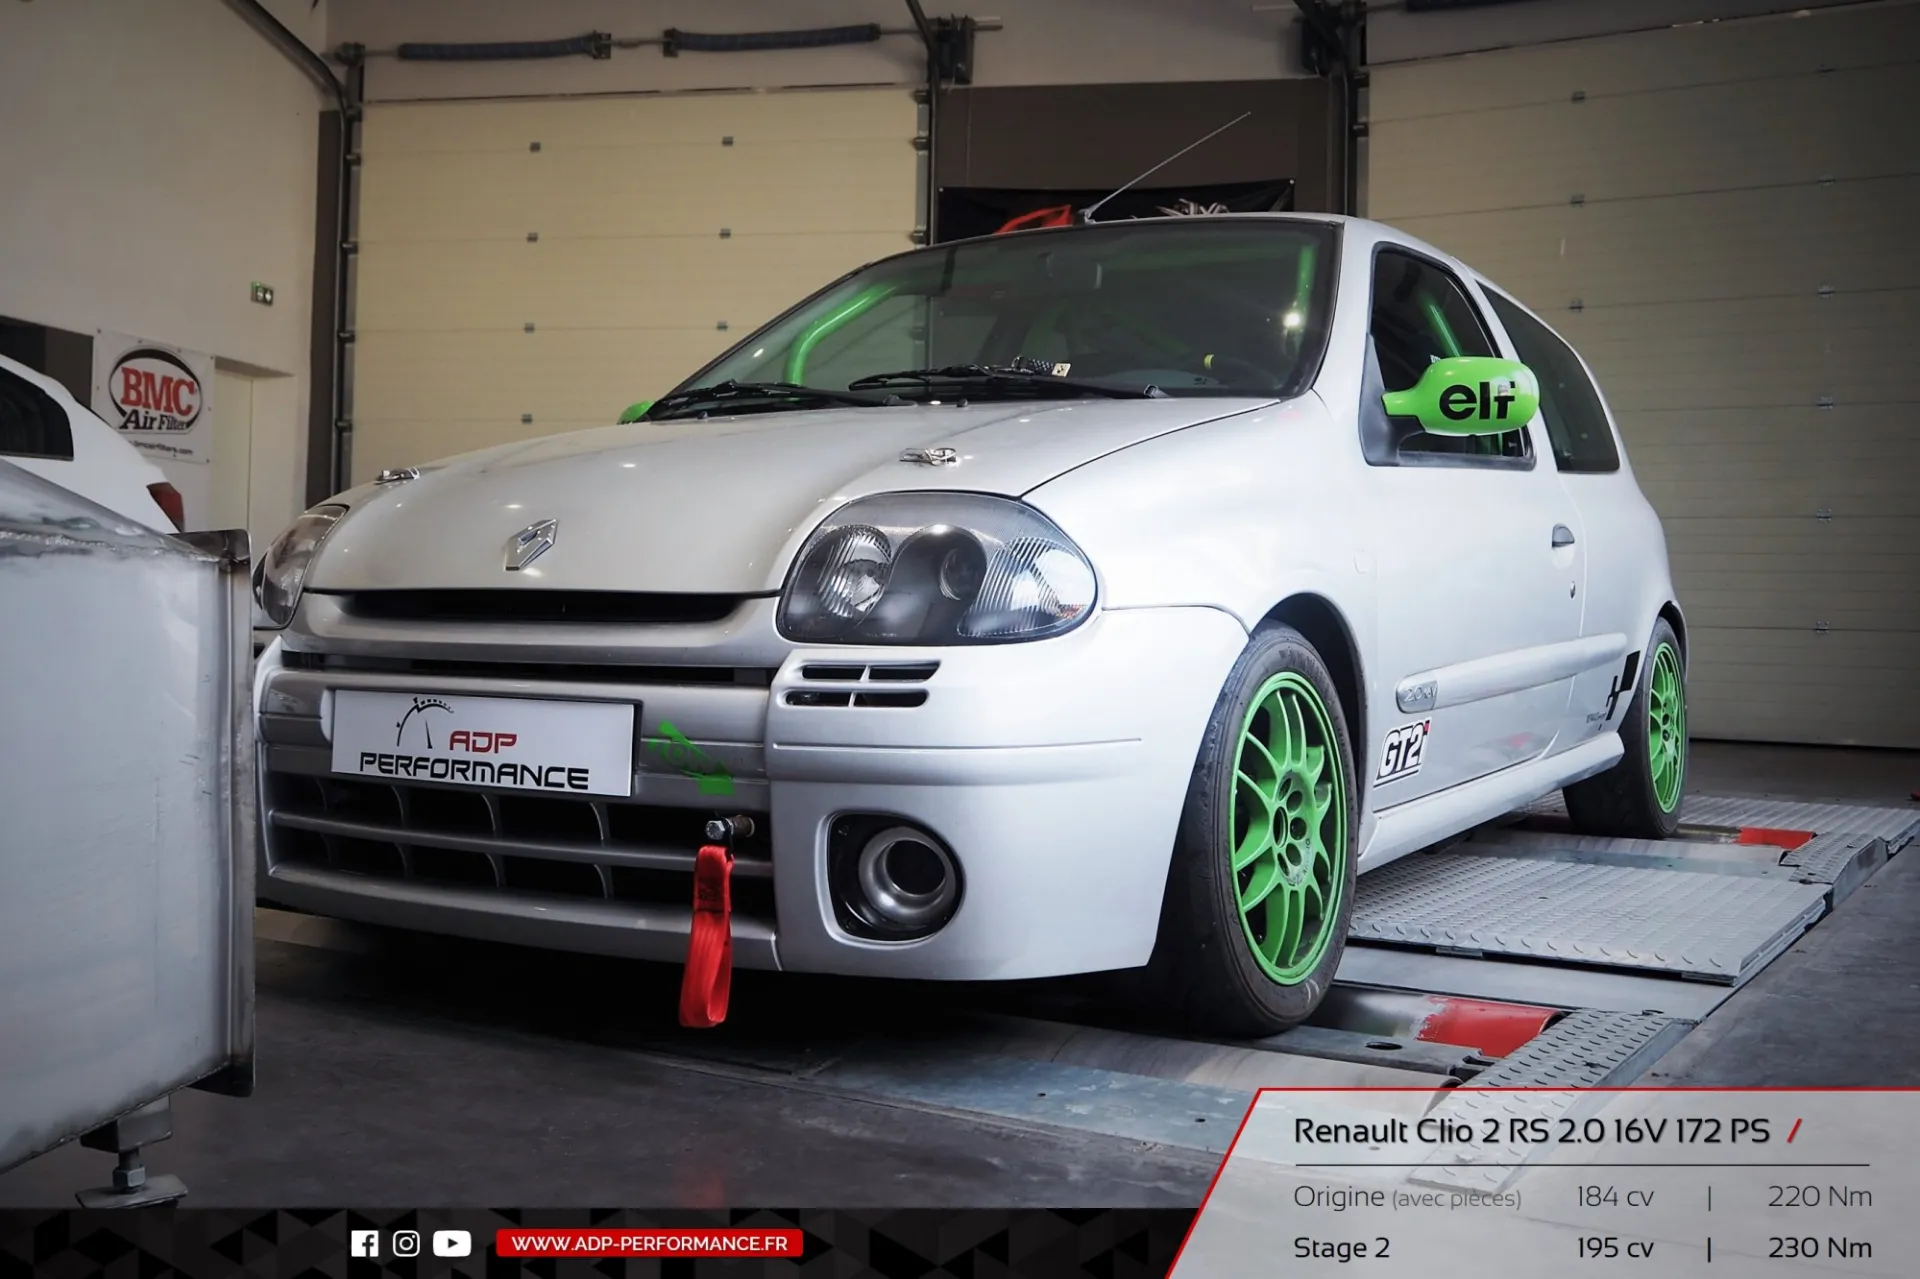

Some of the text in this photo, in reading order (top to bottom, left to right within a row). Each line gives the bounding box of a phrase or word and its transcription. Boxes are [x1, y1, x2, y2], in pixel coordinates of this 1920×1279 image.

[120, 366, 195, 416] BMC
[1439, 381, 1515, 420] elf
[119, 409, 157, 430] Air
[449, 730, 517, 754] ADP
[360, 752, 589, 790] PERFORMANCE
